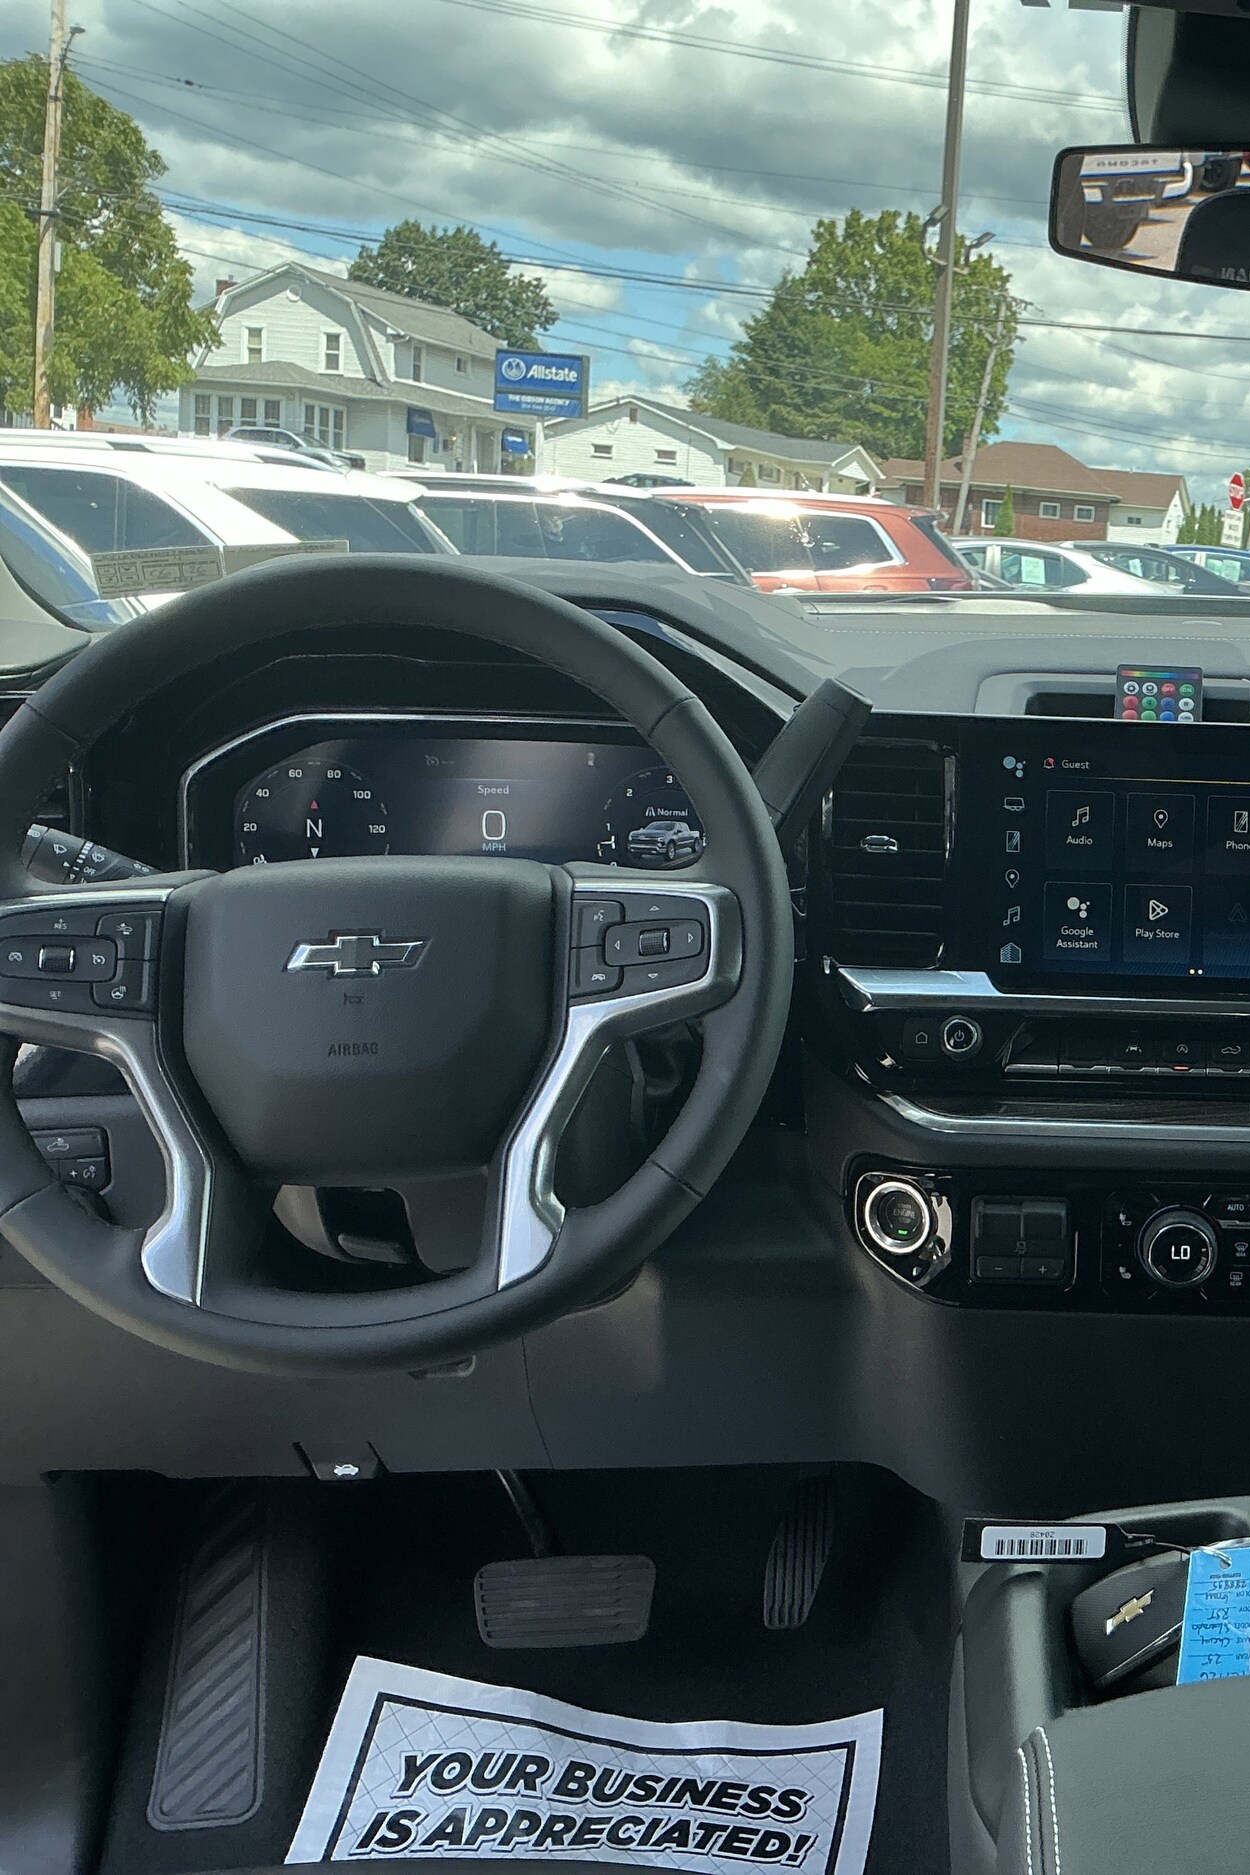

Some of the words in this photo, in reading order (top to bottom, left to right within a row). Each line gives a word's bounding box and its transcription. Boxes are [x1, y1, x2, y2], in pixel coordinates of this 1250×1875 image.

[527, 364, 578, 382] Allstate
[1061, 759, 1090, 769] Guest
[288, 769, 302, 778] 60
[327, 769, 341, 778] 80
[665, 775, 673, 784] 3
[256, 788, 270, 798] 40
[353, 790, 371, 799] 100
[477, 785, 510, 796] Speed
[626, 788, 633, 797] 2
[656, 807, 689, 817] Normal
[243, 822, 257, 832] 20
[306, 818, 323, 838] N
[368, 824, 386, 834] 120
[482, 810, 507, 841] 0
[1066, 835, 1093, 845] Audio
[1147, 838, 1173, 850] Maps
[482, 842, 507, 852] MPH
[83, 866, 97, 876] OFF
[54, 922, 67, 930] RES
[1060, 926, 1094, 938] Google
[1135, 928, 1154, 939] Play
[1155, 929, 1180, 939] Store
[1056, 939, 1098, 949] Assistant
[327, 1041, 380, 1057] AIRBAG
[1171, 1245, 1190, 1260] LO
[1207, 1607, 1230, 1620] RST
[1200, 1635, 1231, 1648] Chevy
[395, 1750, 551, 1797] YOUR
[557, 1761, 812, 1821] BUSINESS
[356, 1809, 424, 1850] IS
[420, 1807, 817, 1864] APPRECIATED!
